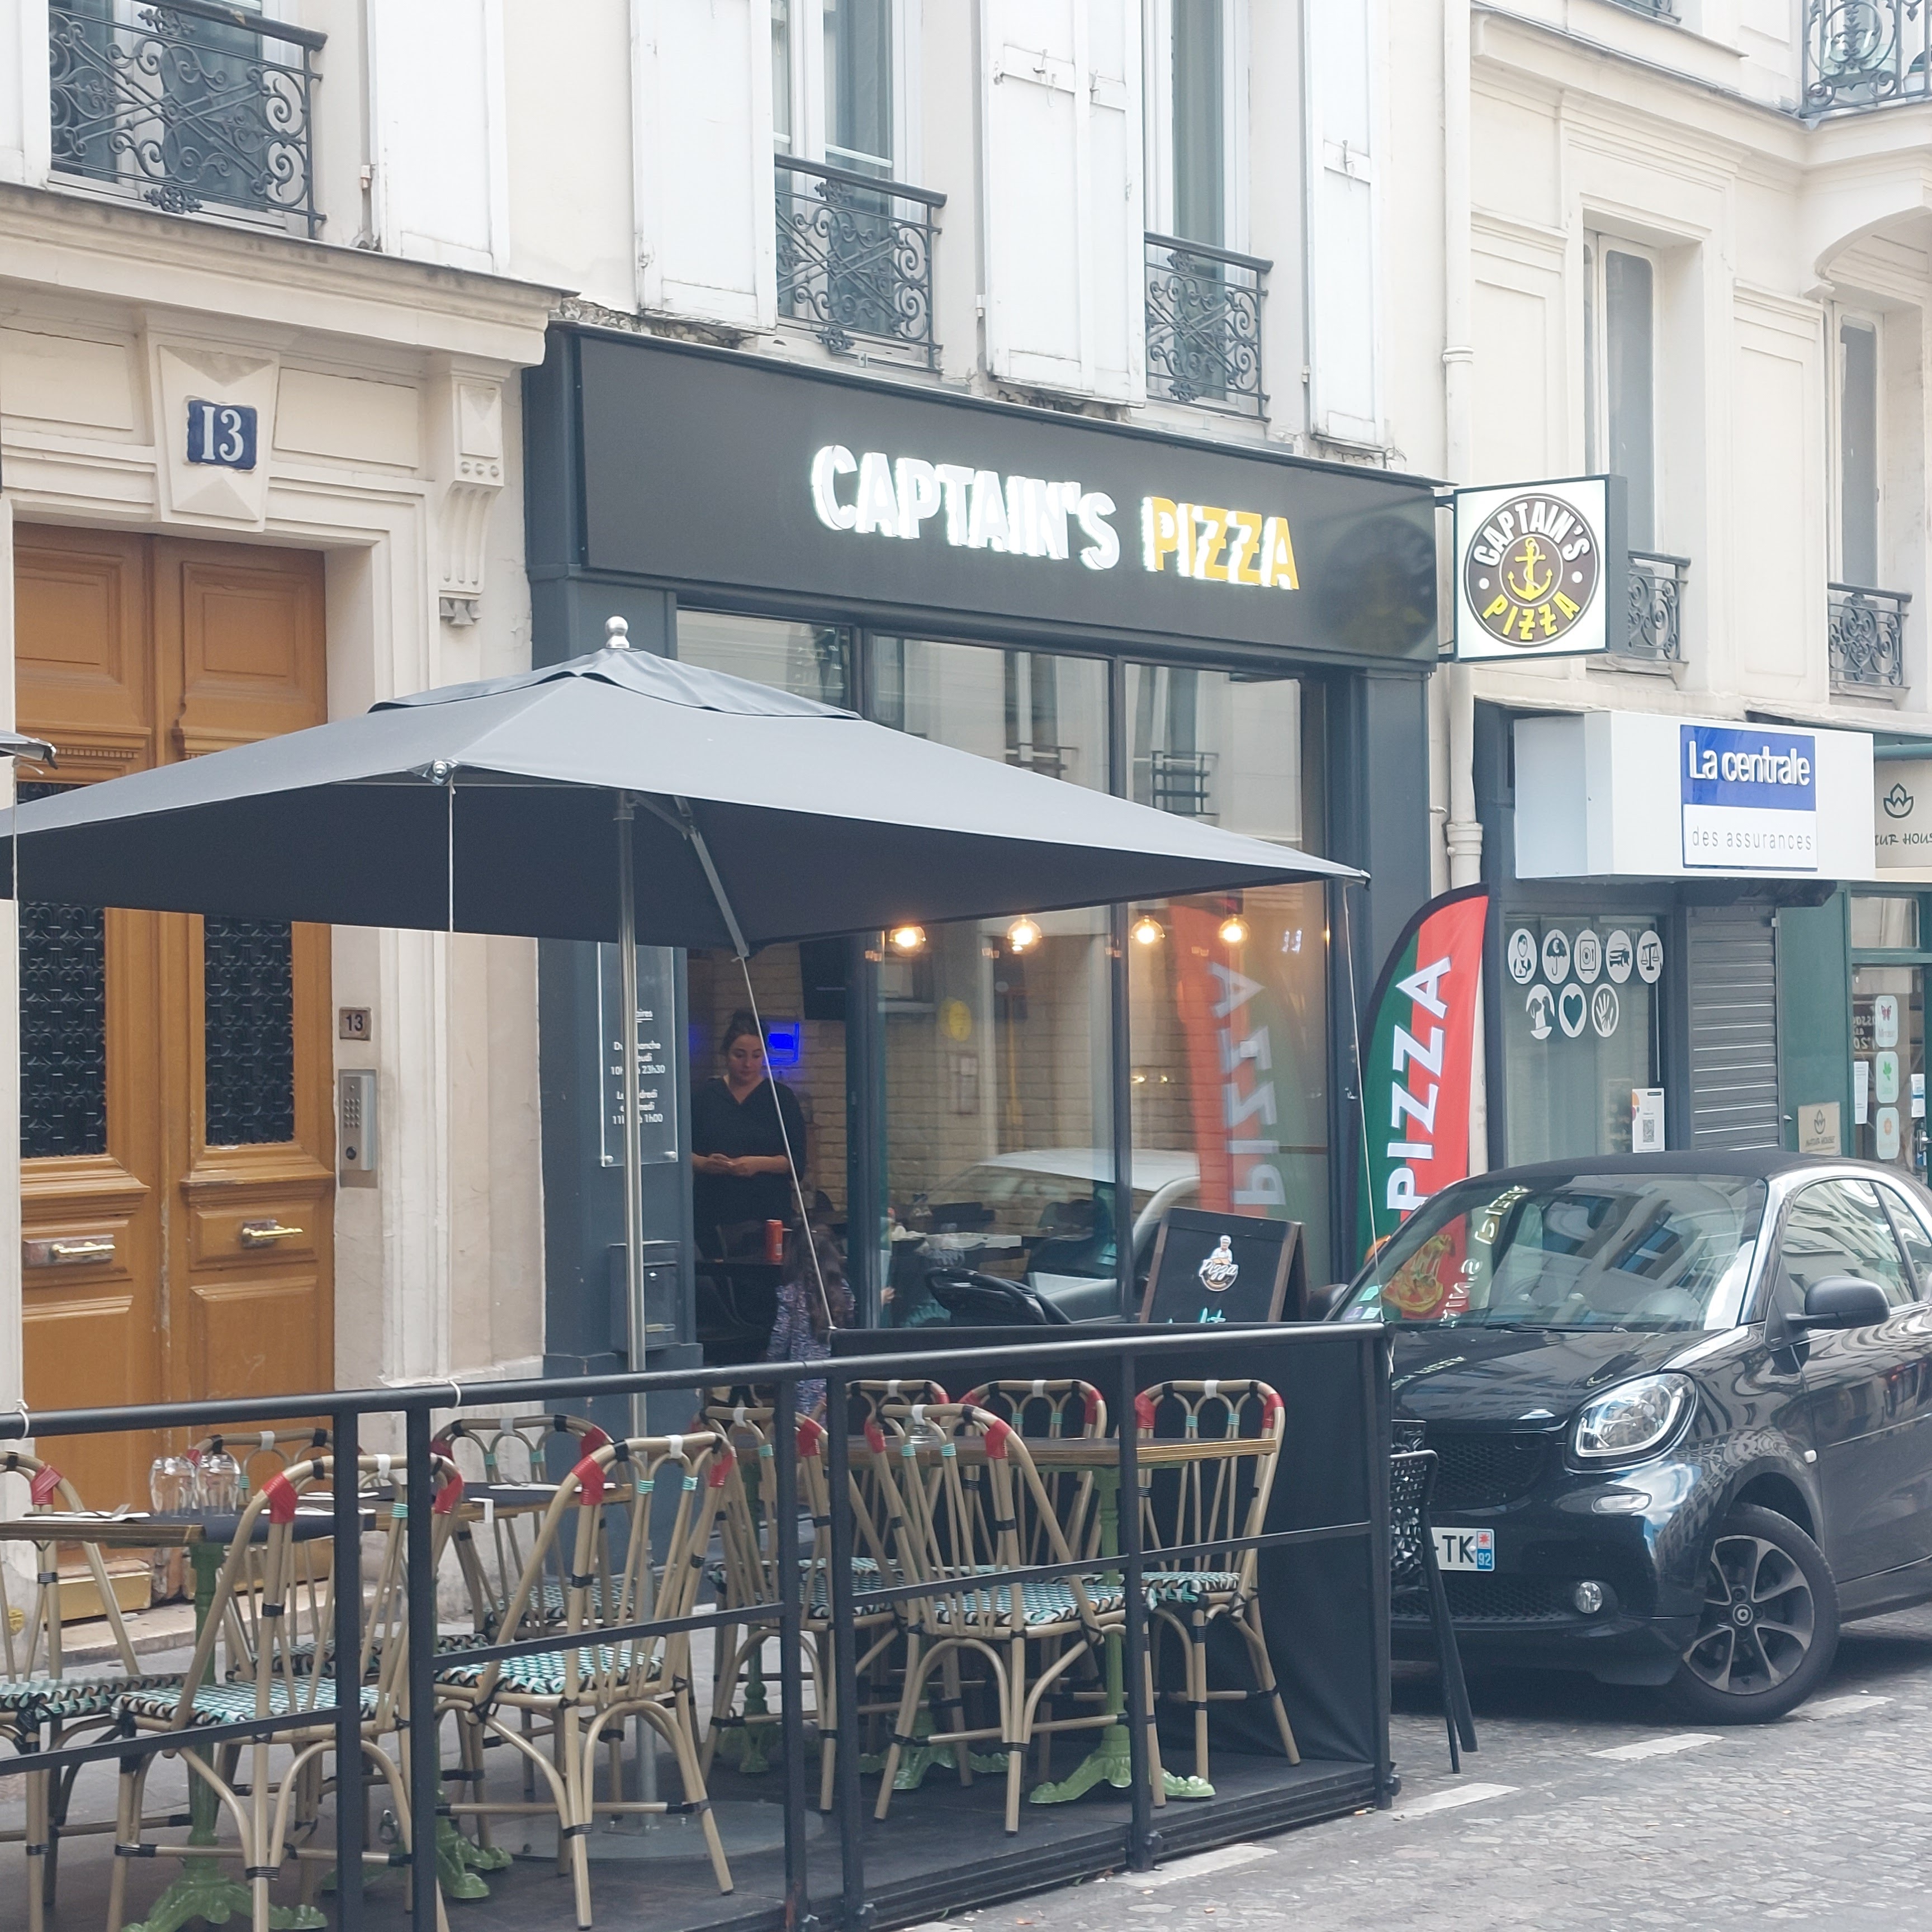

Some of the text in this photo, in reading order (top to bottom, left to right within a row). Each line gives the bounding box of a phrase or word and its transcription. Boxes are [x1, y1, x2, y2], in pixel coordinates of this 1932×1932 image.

[202, 405, 244, 462] 13
[811, 444, 1300, 590] CAPTAIN'S PIZZA
[1474, 501, 1590, 567] CAPTAIN'S
[1482, 590, 1581, 641] PIZZA
[1688, 740, 1811, 786] La centrale
[1692, 826, 1812, 851] des assurances
[345, 1014, 364, 1032] 13
[641, 1064, 666, 1074] 23h30
[1386, 955, 1452, 1211] PIZZA
[1200, 1259, 1238, 1281] Pizza
[1478, 1552, 1491, 1566] 92
